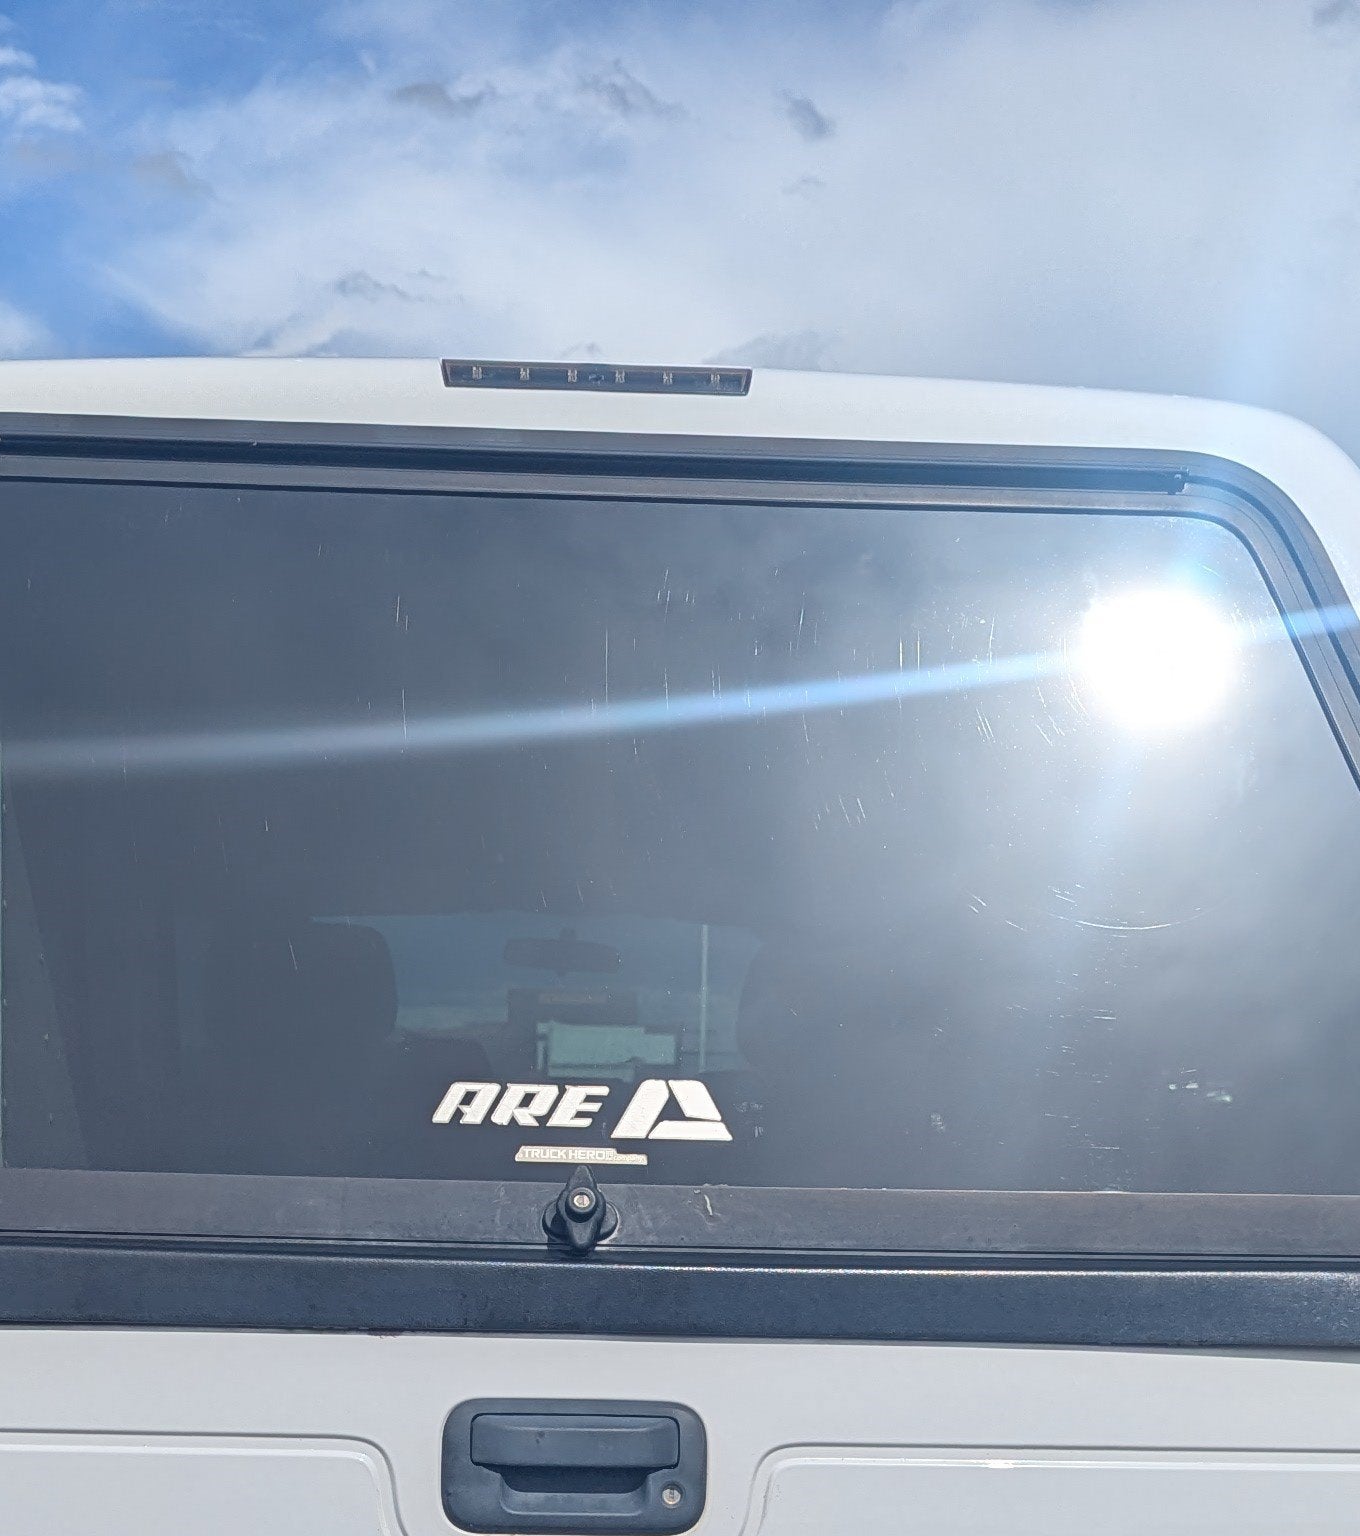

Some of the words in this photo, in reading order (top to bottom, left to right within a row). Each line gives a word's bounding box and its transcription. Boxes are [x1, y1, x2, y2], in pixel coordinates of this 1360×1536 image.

[432, 1081, 610, 1127] ARE
[523, 1148, 567, 1160] TRUCK
[568, 1149, 605, 1161] HERO
